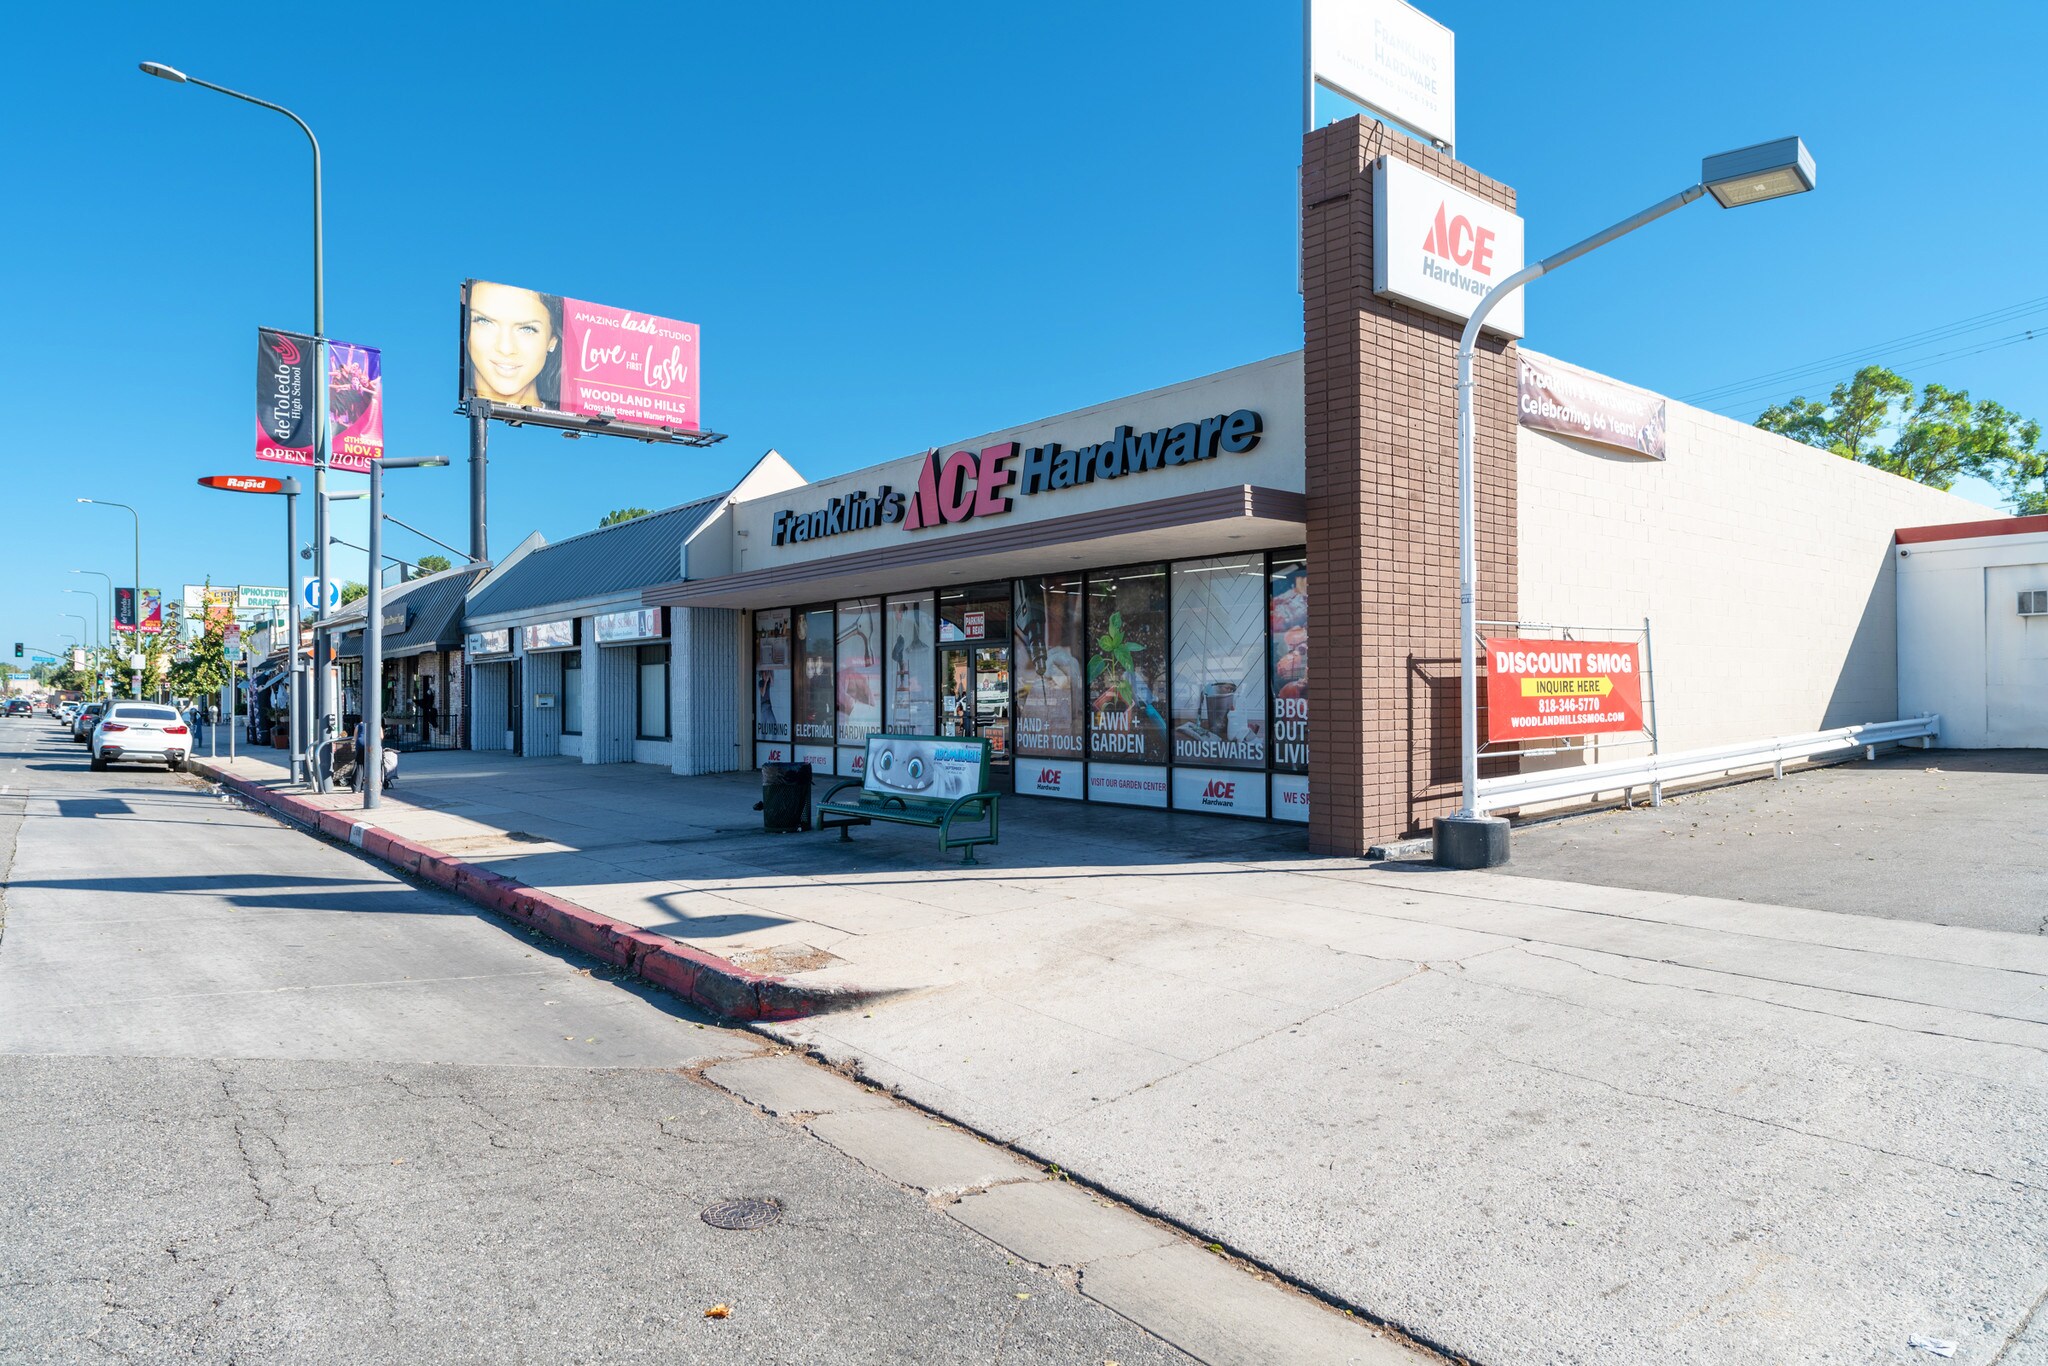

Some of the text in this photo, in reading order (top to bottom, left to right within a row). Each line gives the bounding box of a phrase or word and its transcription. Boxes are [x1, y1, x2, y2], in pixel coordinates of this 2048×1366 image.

[1374, 42, 1438, 95] HARDWARE
[1422, 199, 1495, 277] ACE
[575, 312, 691, 342] AMAZING lash STUDIO
[581, 328, 688, 390] Love AT FIRST Lash
[292, 367, 303, 419] High School
[580, 387, 686, 413] WOODLAND HILLS
[274, 364, 291, 439] deToledo
[583, 401, 604, 412] Across
[616, 407, 635, 416] street
[643, 410, 665, 422] Warner
[666, 412, 683, 425] Plaza
[1521, 393, 1637, 439] Celebrating 66 Years!
[262, 447, 307, 462] OPEN
[344, 444, 382, 458] NOV. 3
[331, 453, 372, 469] HOUS
[227, 477, 266, 489] Rapid
[771, 408, 1264, 546] Franklin's ACE Hardware
[240, 587, 288, 597] UPHOLSTERY
[248, 597, 280, 606] DRAPERY
[966, 615, 984, 625] PARKING
[966, 626, 971, 635] IN
[972, 625, 984, 635] REAR
[1496, 651, 1632, 674] DISCOUNT SMOG
[1536, 680, 1600, 695] INQUIRE HERE
[1275, 698, 1308, 720] BBQ
[1538, 698, 1600, 713] 818-346-5770
[1016, 717, 1042, 732] HAND
[1091, 711, 1128, 731] LAWN
[1511, 712, 1625, 728] WOODLANDHILLSSMOG.COM
[758, 722, 788, 737] PLUMBING
[795, 724, 834, 739] ELECTRICAL
[1275, 721, 1308, 742] OUT
[1016, 734, 1049, 749] POWER
[1051, 734, 1083, 751] TOOLS
[1091, 733, 1145, 754] GARDEN
[1176, 740, 1264, 761] HOUSEWARES
[768, 749, 781, 761] ACE
[852, 755, 864, 768] AC
[1275, 743, 1309, 764] LIVI
[1037, 767, 1062, 785] ACE
[1037, 784, 1060, 792] Hardware
[1090, 777, 1167, 792] VISIT OUR GARDEN CENTER
[1203, 778, 1236, 799] ACE
[1202, 797, 1234, 808] Hardware
[1283, 791, 1298, 804] WE
